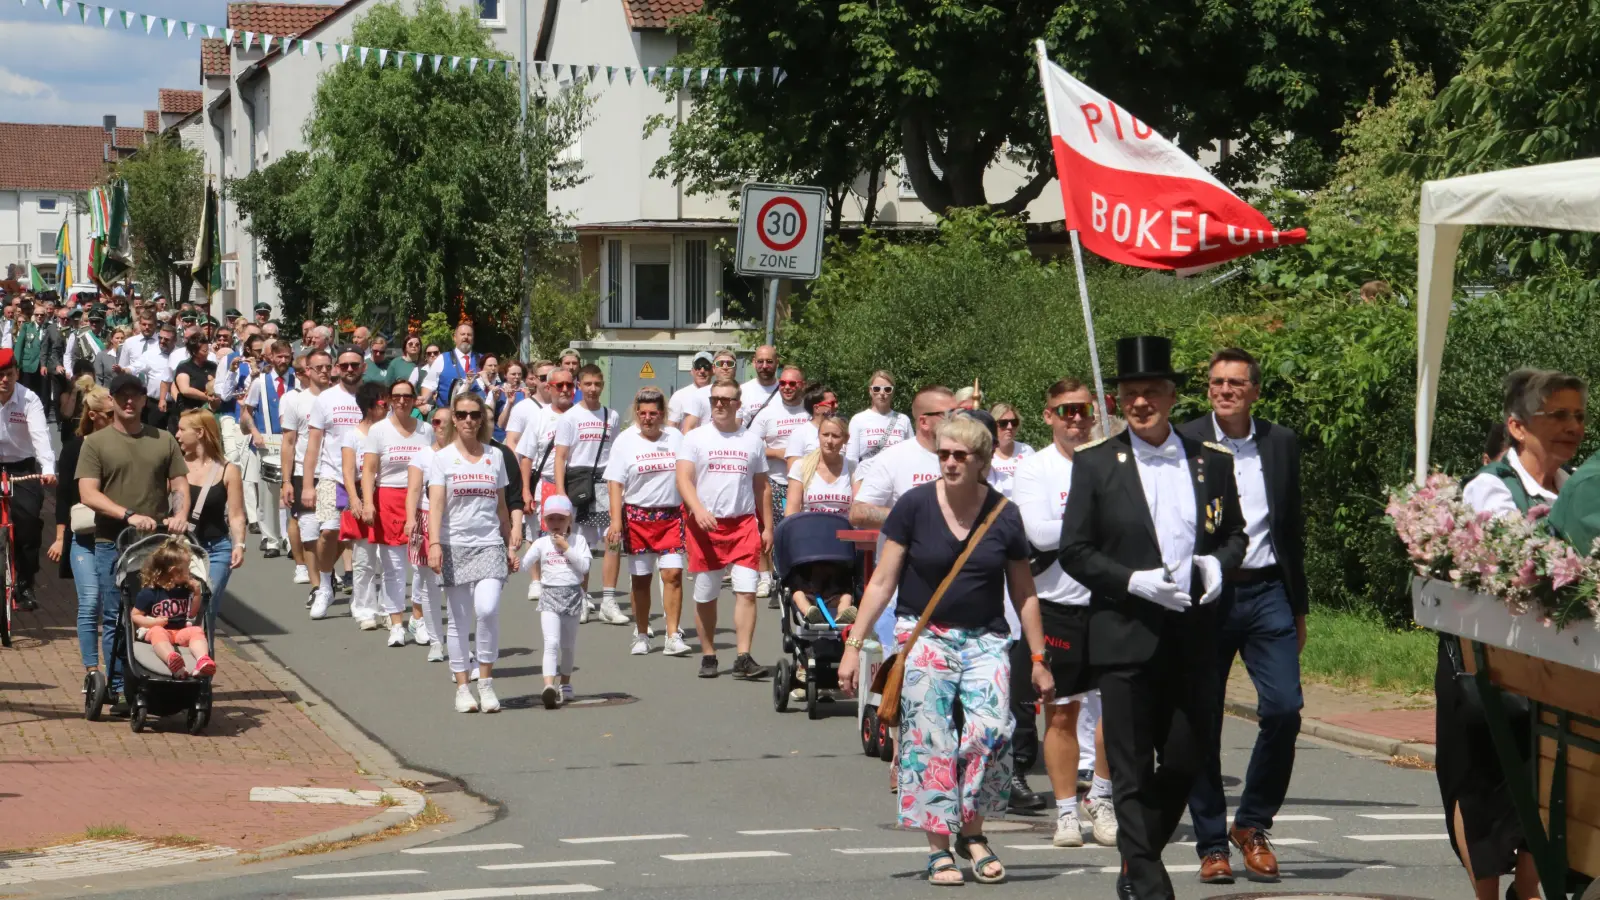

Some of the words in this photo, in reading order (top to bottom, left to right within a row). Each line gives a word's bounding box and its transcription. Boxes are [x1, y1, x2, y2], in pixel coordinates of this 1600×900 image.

[767, 210, 796, 236] 30
[759, 253, 798, 269] ZONE
[635, 451, 676, 461] PIONIERE
[708, 450, 749, 459] PIONIERE
[638, 462, 677, 472] BOKELO
[709, 463, 748, 472] BOKELOH
[453, 473, 495, 481] PIONIERE
[808, 493, 851, 502] PIONIERE
[1044, 634, 1071, 650] Nils
